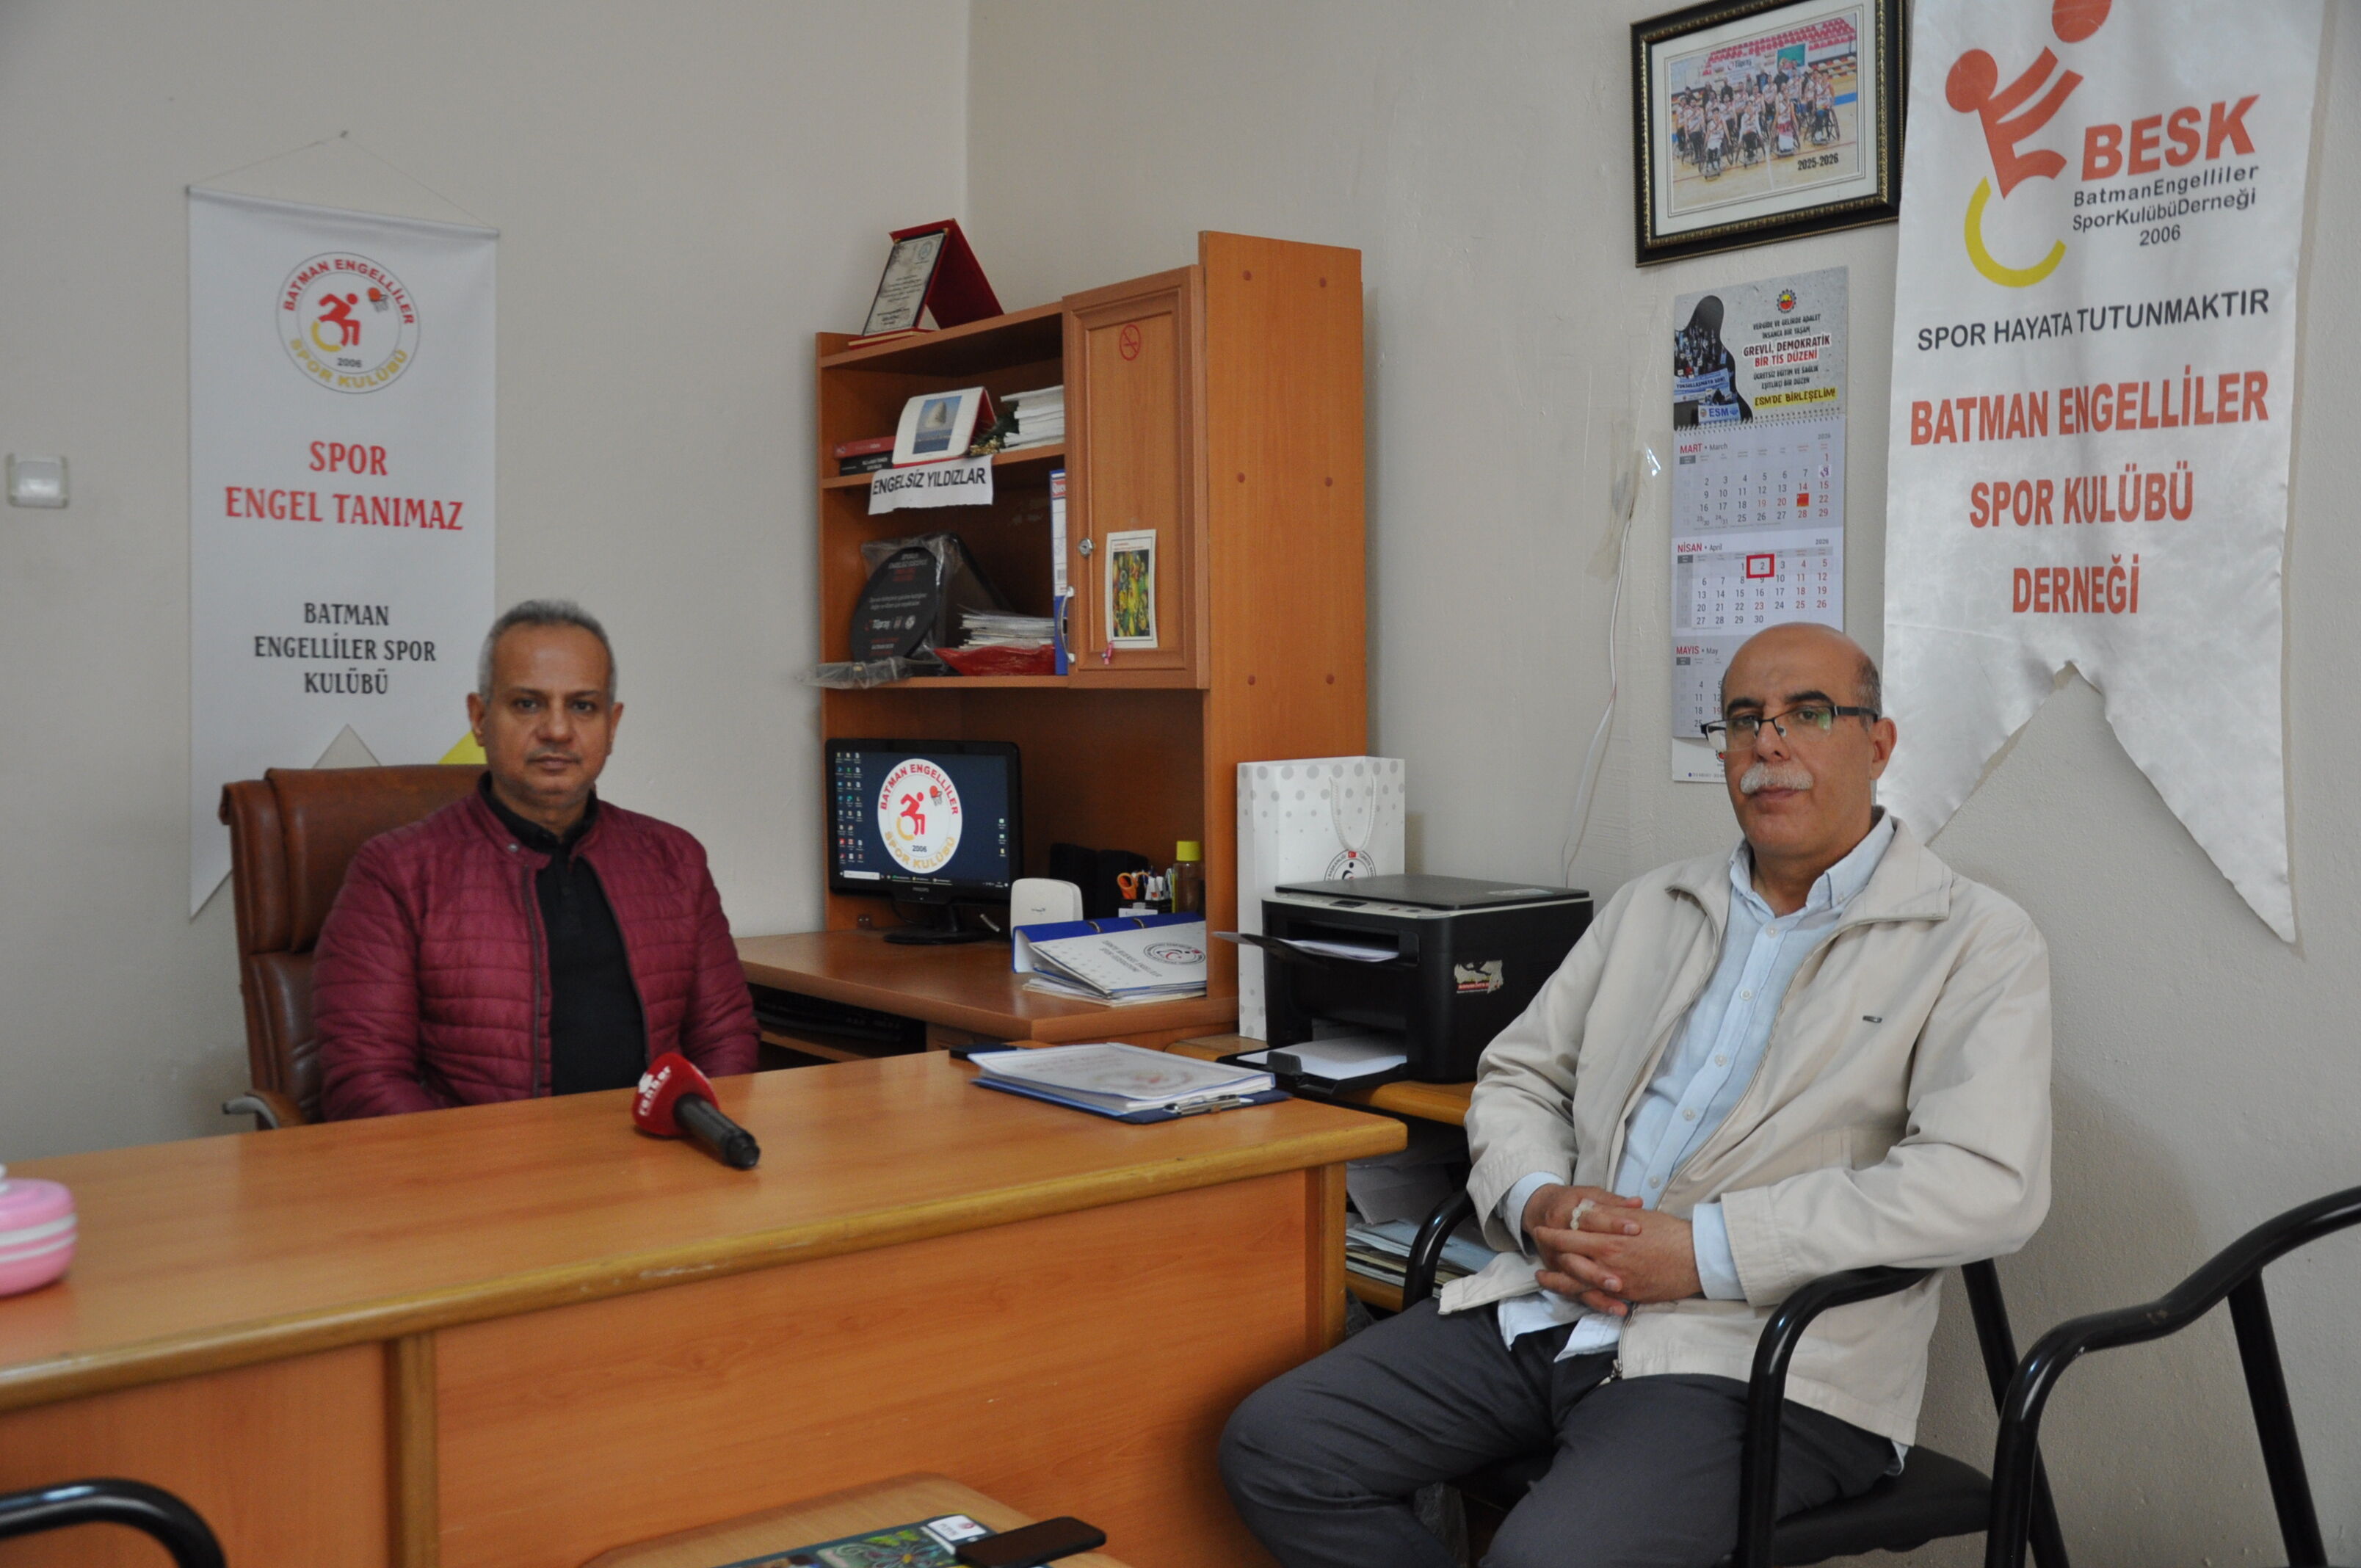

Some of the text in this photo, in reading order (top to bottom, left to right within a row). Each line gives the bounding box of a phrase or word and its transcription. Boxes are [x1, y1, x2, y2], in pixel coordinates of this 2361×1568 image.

[2081, 93, 2261, 181] BESK
[1798, 153, 1839, 170] 2025-2026
[2140, 224, 2181, 247] 2006
[283, 259, 415, 324] BATMAN ENGELLİLER
[1917, 288, 2270, 351] SPOR HAYATA TUTUNMAKTIR
[1777, 333, 1830, 352] DEMOKRATİK
[290, 338, 333, 382] SPOR
[338, 357, 362, 368] 2006
[1787, 347, 1818, 363] DÜZENİ
[1709, 408, 1729, 417] ESM
[1910, 364, 2269, 446] BATMAN ENGELLİLER
[308, 441, 388, 476] SPOR
[1680, 443, 1728, 454] MART March
[872, 468, 985, 496] ENGELSİZ YILDIZLAR
[1719, 489, 1728, 498] 10
[1738, 487, 1747, 496] 11
[1758, 486, 1767, 494] 12
[1778, 484, 1787, 493] 13
[1970, 460, 2194, 528] SPOR KULÜBÜ
[225, 487, 464, 530] ENGEL TANIMAZ
[1700, 504, 1709, 512] 16
[1719, 502, 1727, 511] 17
[1738, 501, 1747, 509] 18
[1738, 514, 1747, 523] 25
[1678, 542, 1722, 553] NİSAN April
[1777, 574, 1785, 582] 10
[2012, 553, 2139, 615] DERNEĞİ
[1698, 591, 1706, 599] 13
[1717, 590, 1724, 598] 14
[1736, 589, 1744, 598] 15
[1755, 588, 1764, 597] 16
[1776, 587, 1785, 595] 17
[304, 603, 389, 626] BATMAN
[1697, 603, 1706, 612] 20
[1716, 603, 1724, 611] 21
[1736, 603, 1744, 611] 22
[1775, 601, 1784, 609] 24
[1697, 615, 1763, 625] 27 28 29 30
[254, 631, 436, 662] ENGELLİLER SPOR
[1676, 646, 1700, 655] MAYIS
[304, 668, 388, 694] KULÜBÜ
[881, 767, 907, 810] BATMAN
[910, 764, 958, 815] ENGELLİLER
[885, 831, 910, 864] SPOR
